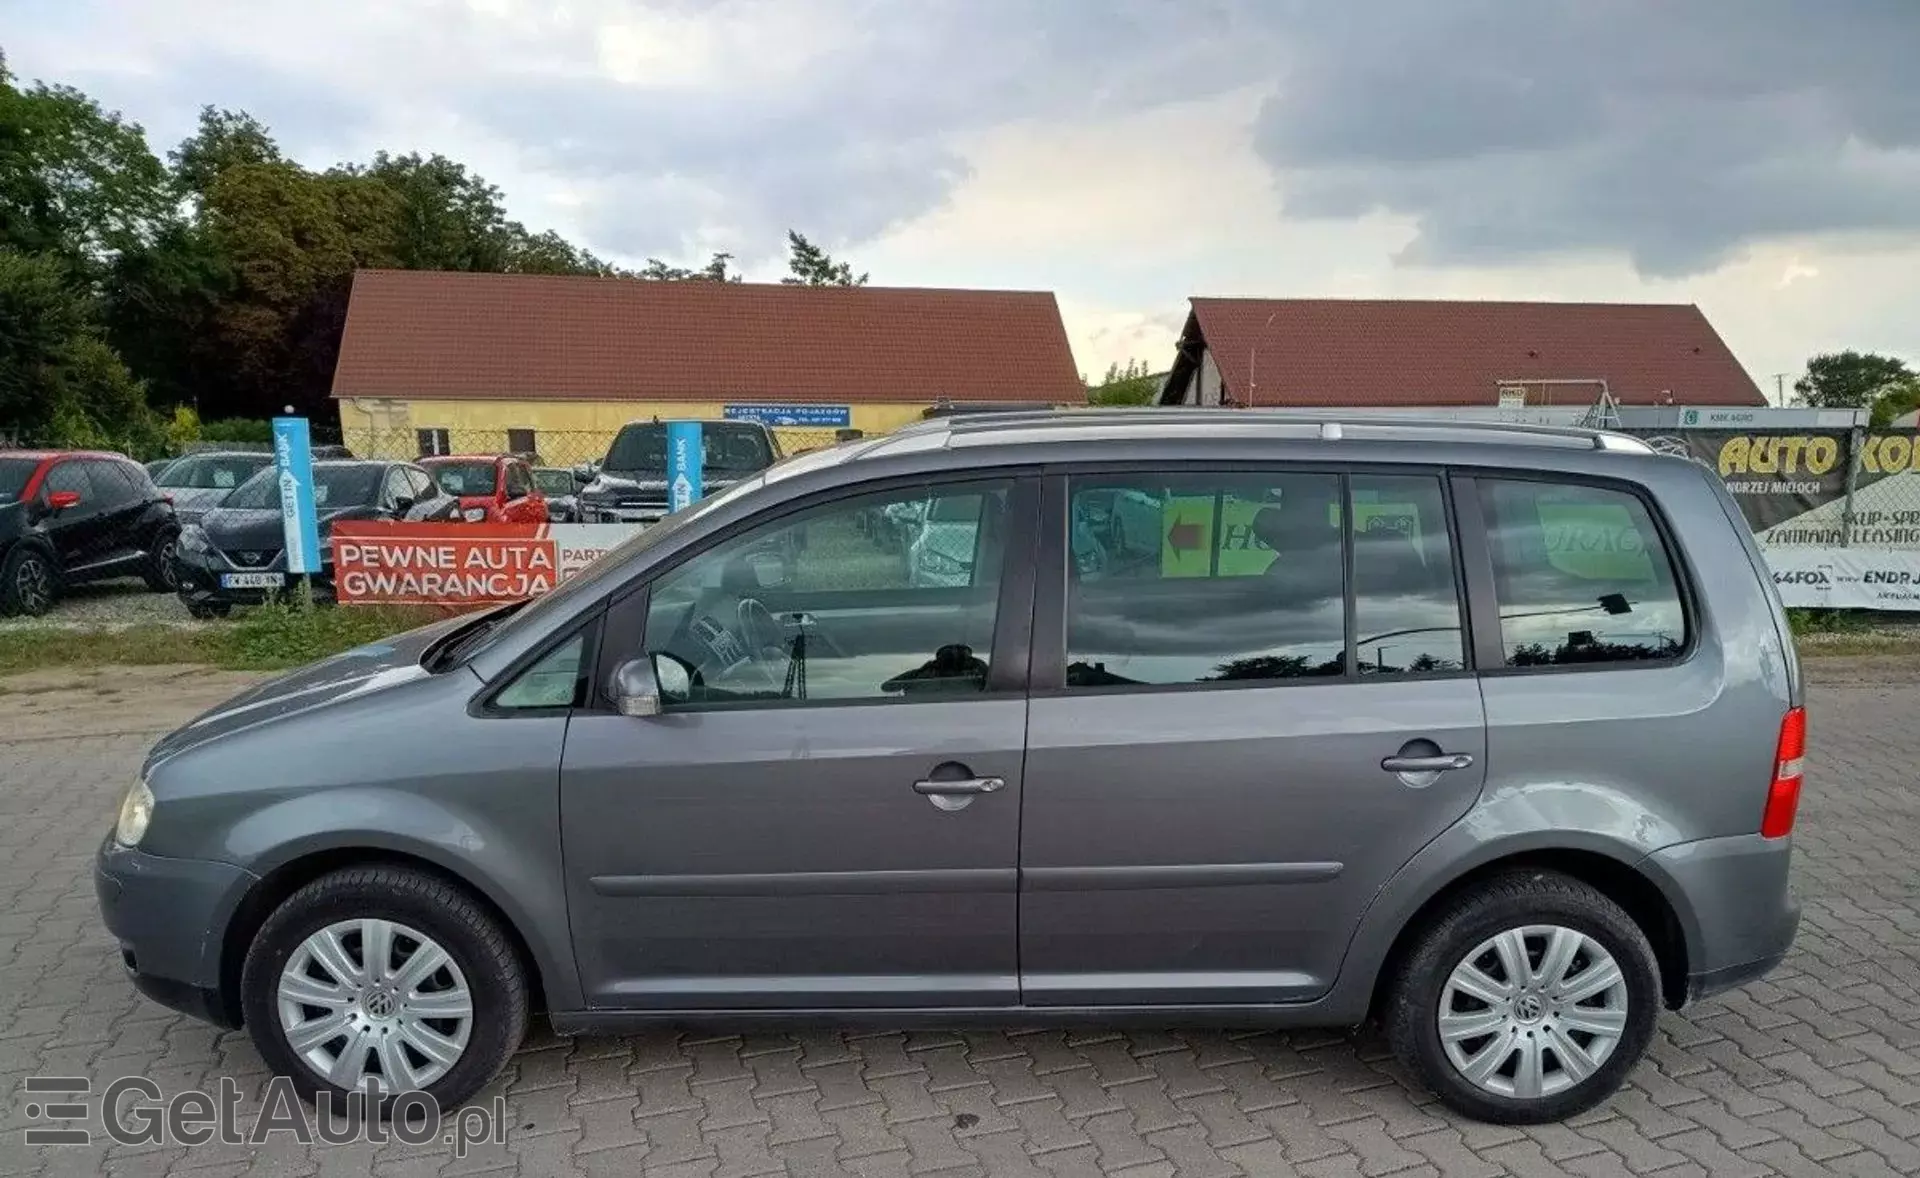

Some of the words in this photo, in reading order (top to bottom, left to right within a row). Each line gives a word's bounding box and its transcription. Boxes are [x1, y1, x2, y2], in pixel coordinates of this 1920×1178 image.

[1718, 436, 1838, 477] AUTO
[1860, 435, 1920, 475] KO
[1726, 481, 1768, 494] NDRZEJ
[1852, 528, 1920, 544] LEASING
[340, 544, 456, 569] PEWNE
[464, 546, 552, 570] AUTA
[562, 549, 608, 562] PART
[343, 571, 550, 597] GWARANCJA
